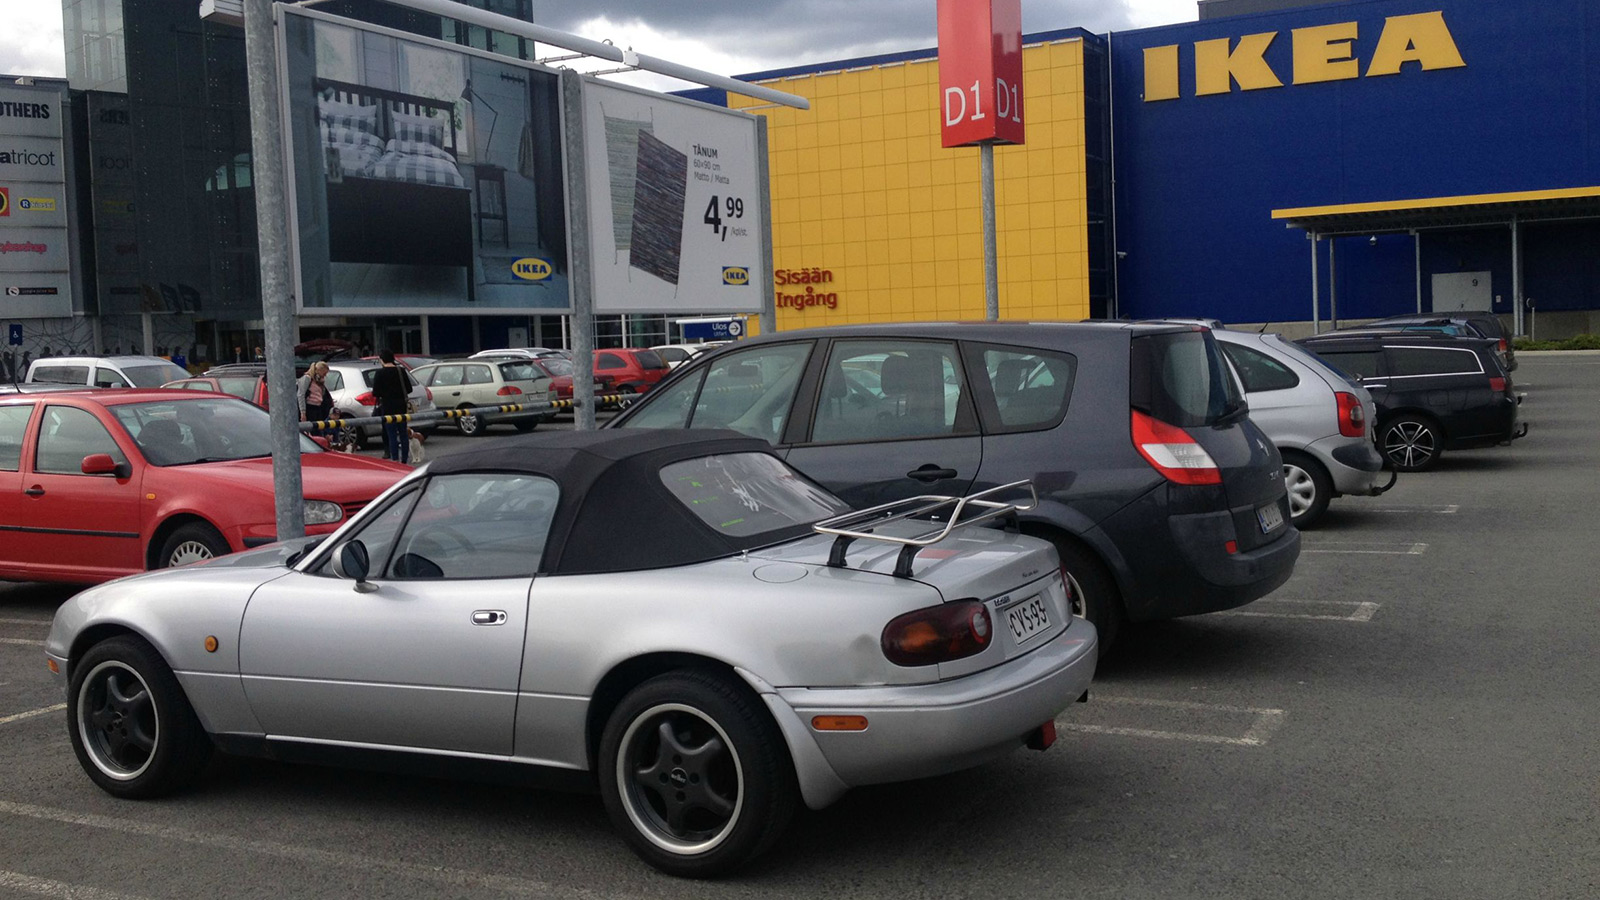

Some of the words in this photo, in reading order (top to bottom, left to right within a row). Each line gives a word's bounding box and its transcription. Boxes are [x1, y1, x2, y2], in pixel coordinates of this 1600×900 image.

[1143, 10, 1467, 102] IKEA
[945, 80, 985, 127] D1
[997, 77, 1021, 123] D1
[516, 263, 547, 274] IKEA
[726, 271, 746, 280] IKEA
[775, 267, 833, 285] Sisään
[776, 285, 838, 311] Ingång
[712, 323, 728, 331] Ulos
[1010, 600, 1047, 638] CVS-93
